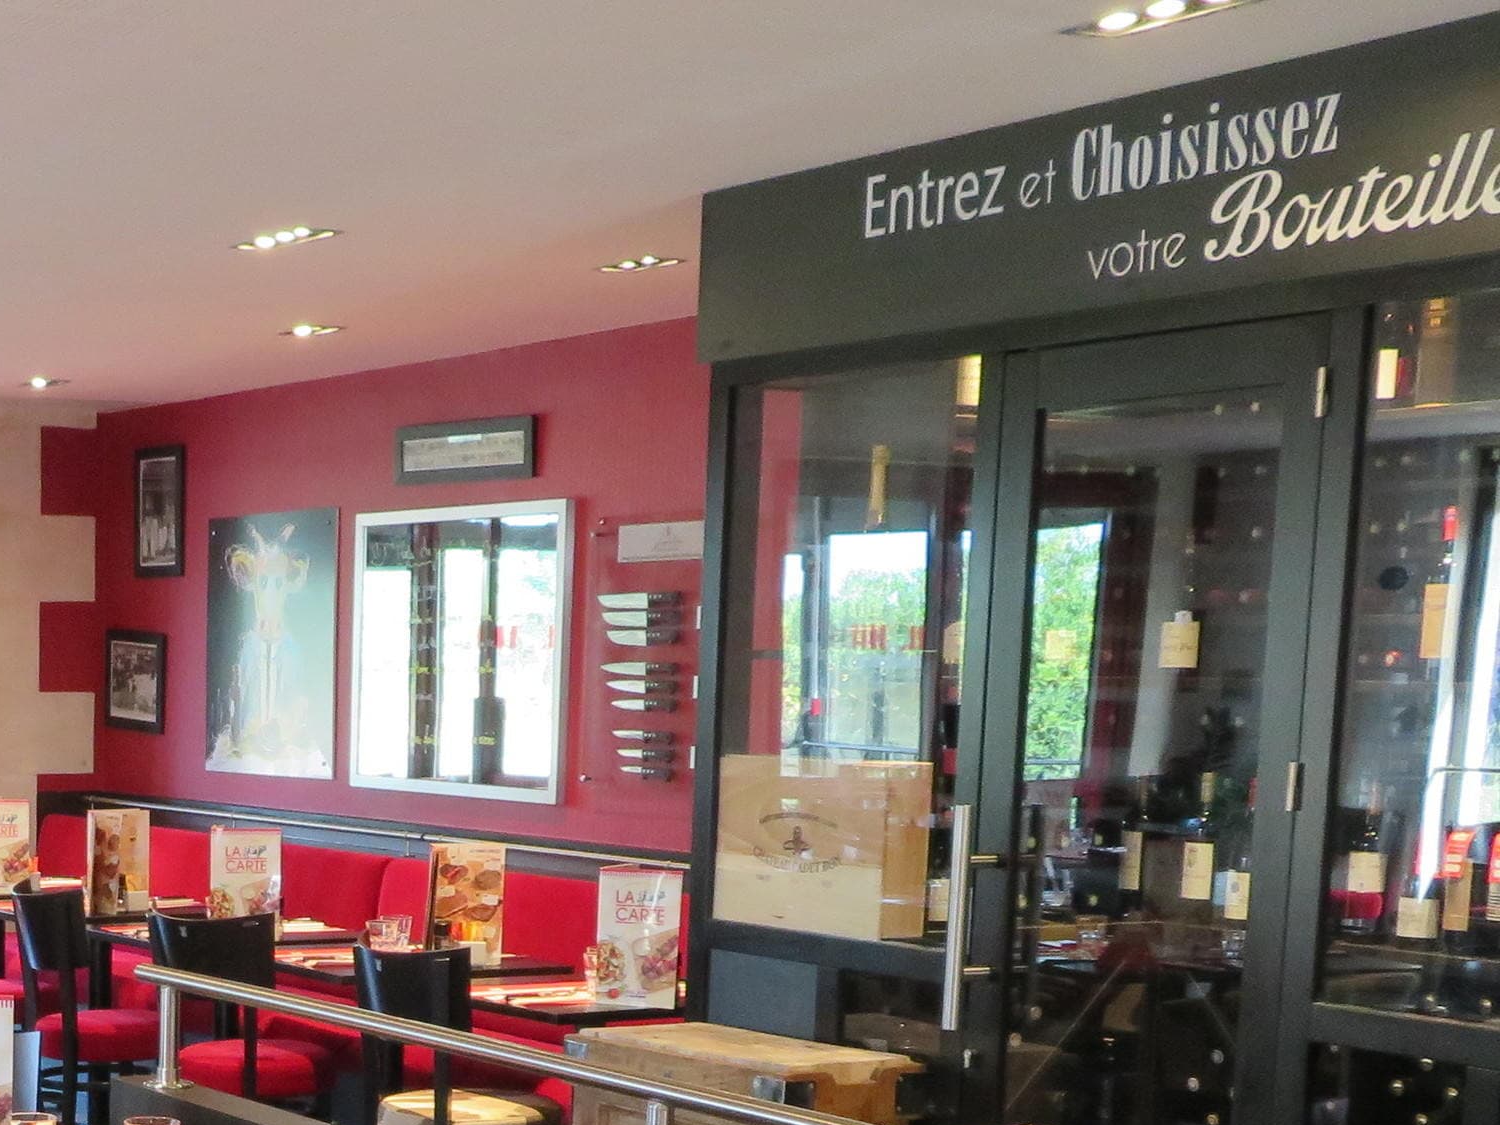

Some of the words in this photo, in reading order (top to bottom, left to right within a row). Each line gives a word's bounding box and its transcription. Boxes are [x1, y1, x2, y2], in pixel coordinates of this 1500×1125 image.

[864, 165, 1007, 239] Entrez
[1019, 158, 1056, 209] et
[1071, 92, 1341, 202] Choisissez
[1087, 228, 1187, 281] votre
[225, 846, 240, 857] LA
[225, 860, 267, 872] CARTE
[615, 889, 635, 904] LA
